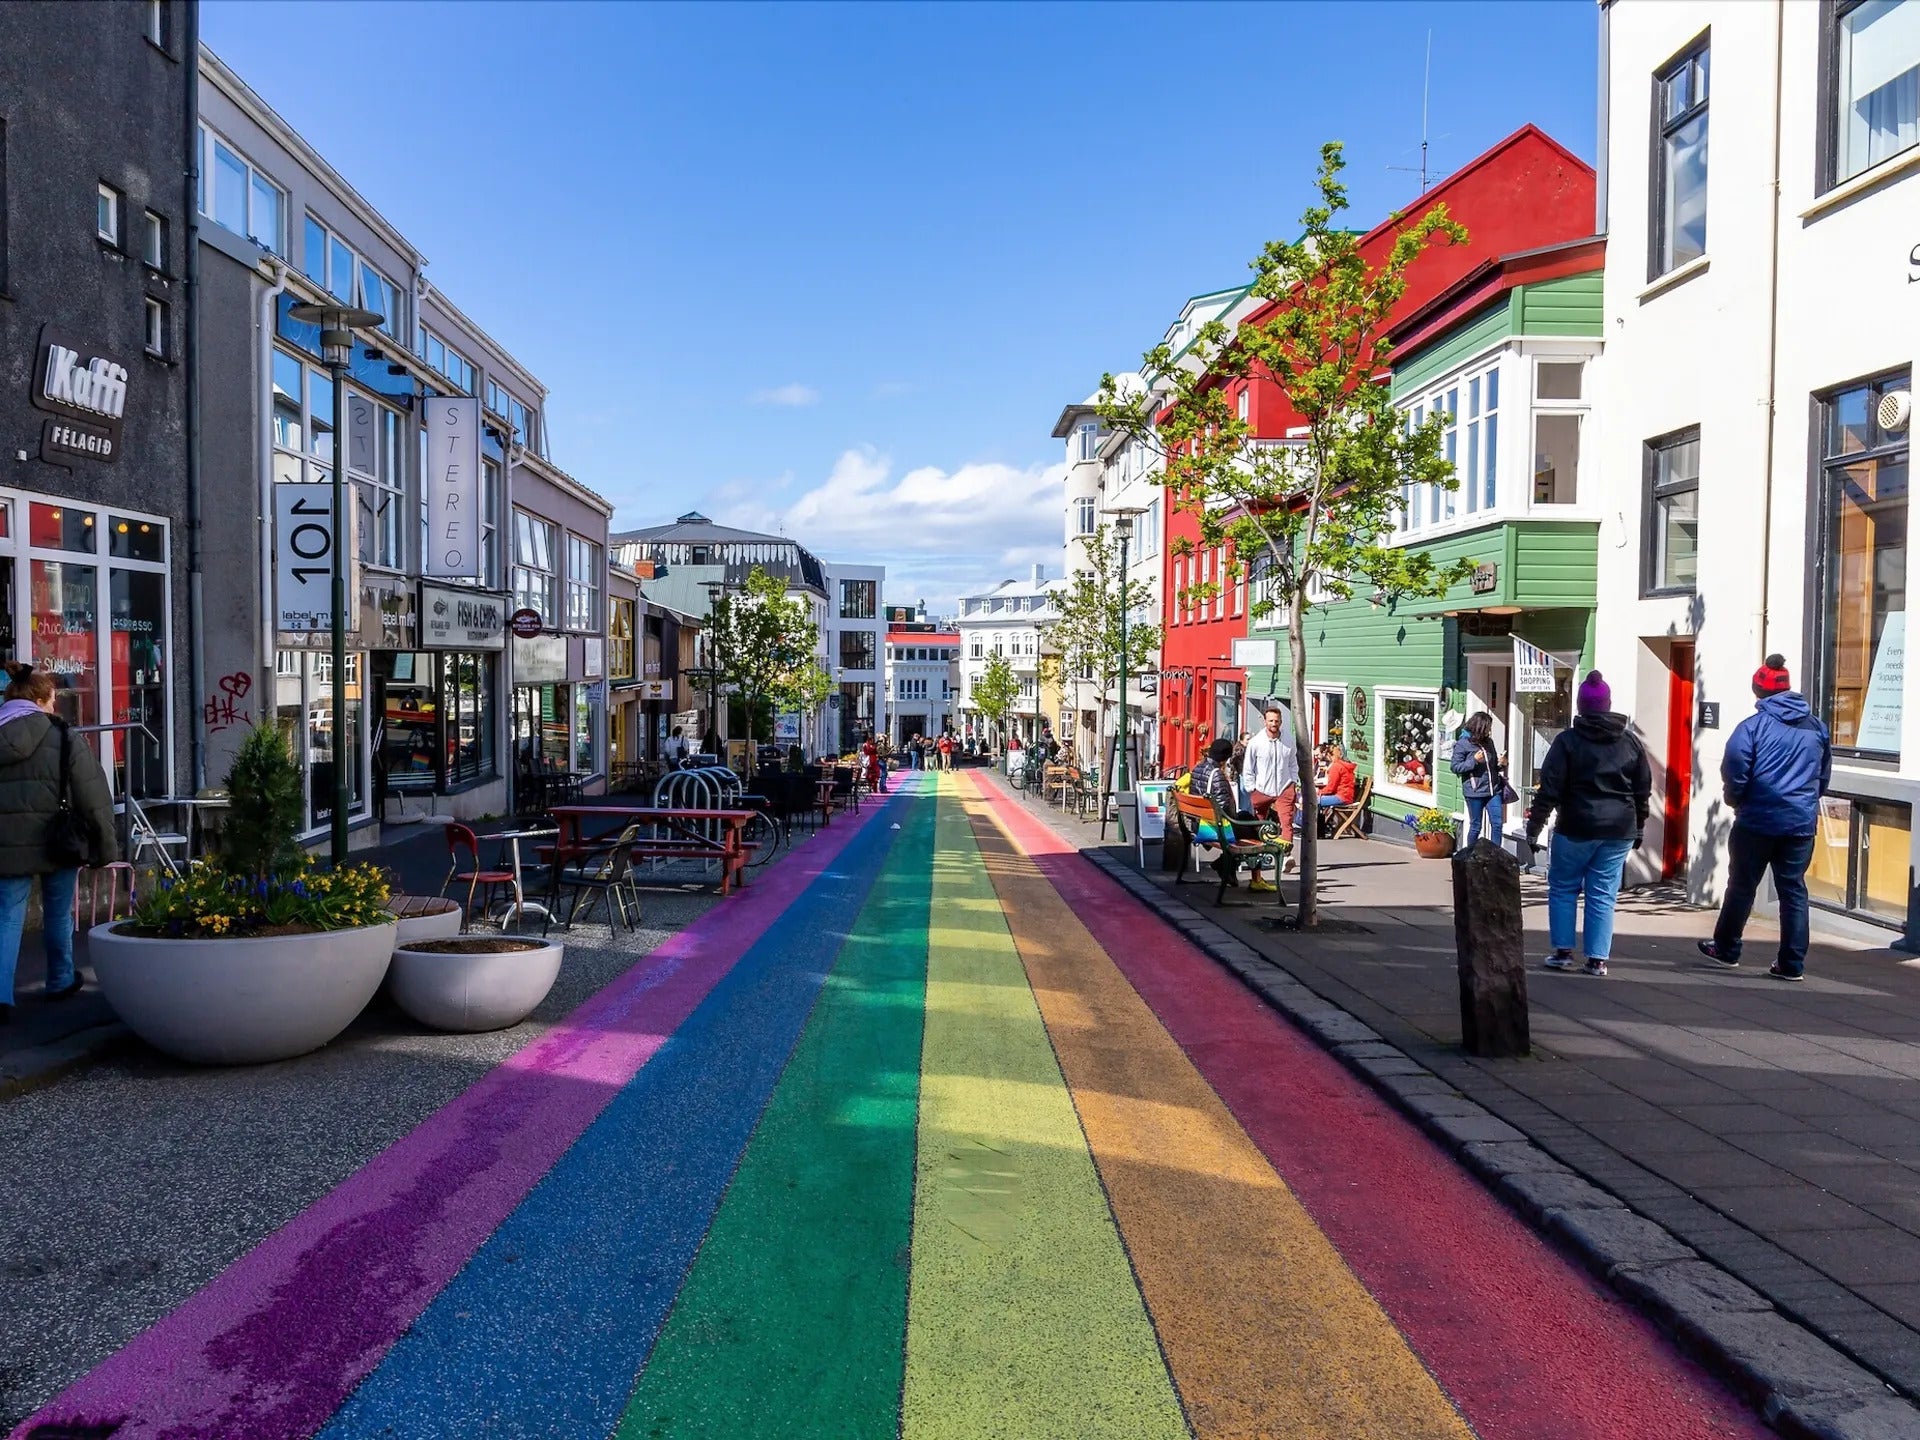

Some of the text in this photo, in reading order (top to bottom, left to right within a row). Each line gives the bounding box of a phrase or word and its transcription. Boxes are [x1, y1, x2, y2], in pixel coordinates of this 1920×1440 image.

[44, 344, 128, 419] Kaffi
[51, 426, 112, 455] FÉLAGIÐ
[290, 498, 331, 585] 101
[457, 599, 473, 627] FISH
[473, 604, 479, 628] &
[479, 603, 497, 630] CHIPS
[1520, 667, 1550, 676] TAX FREE
[1520, 676, 1551, 685] SHOPPING
